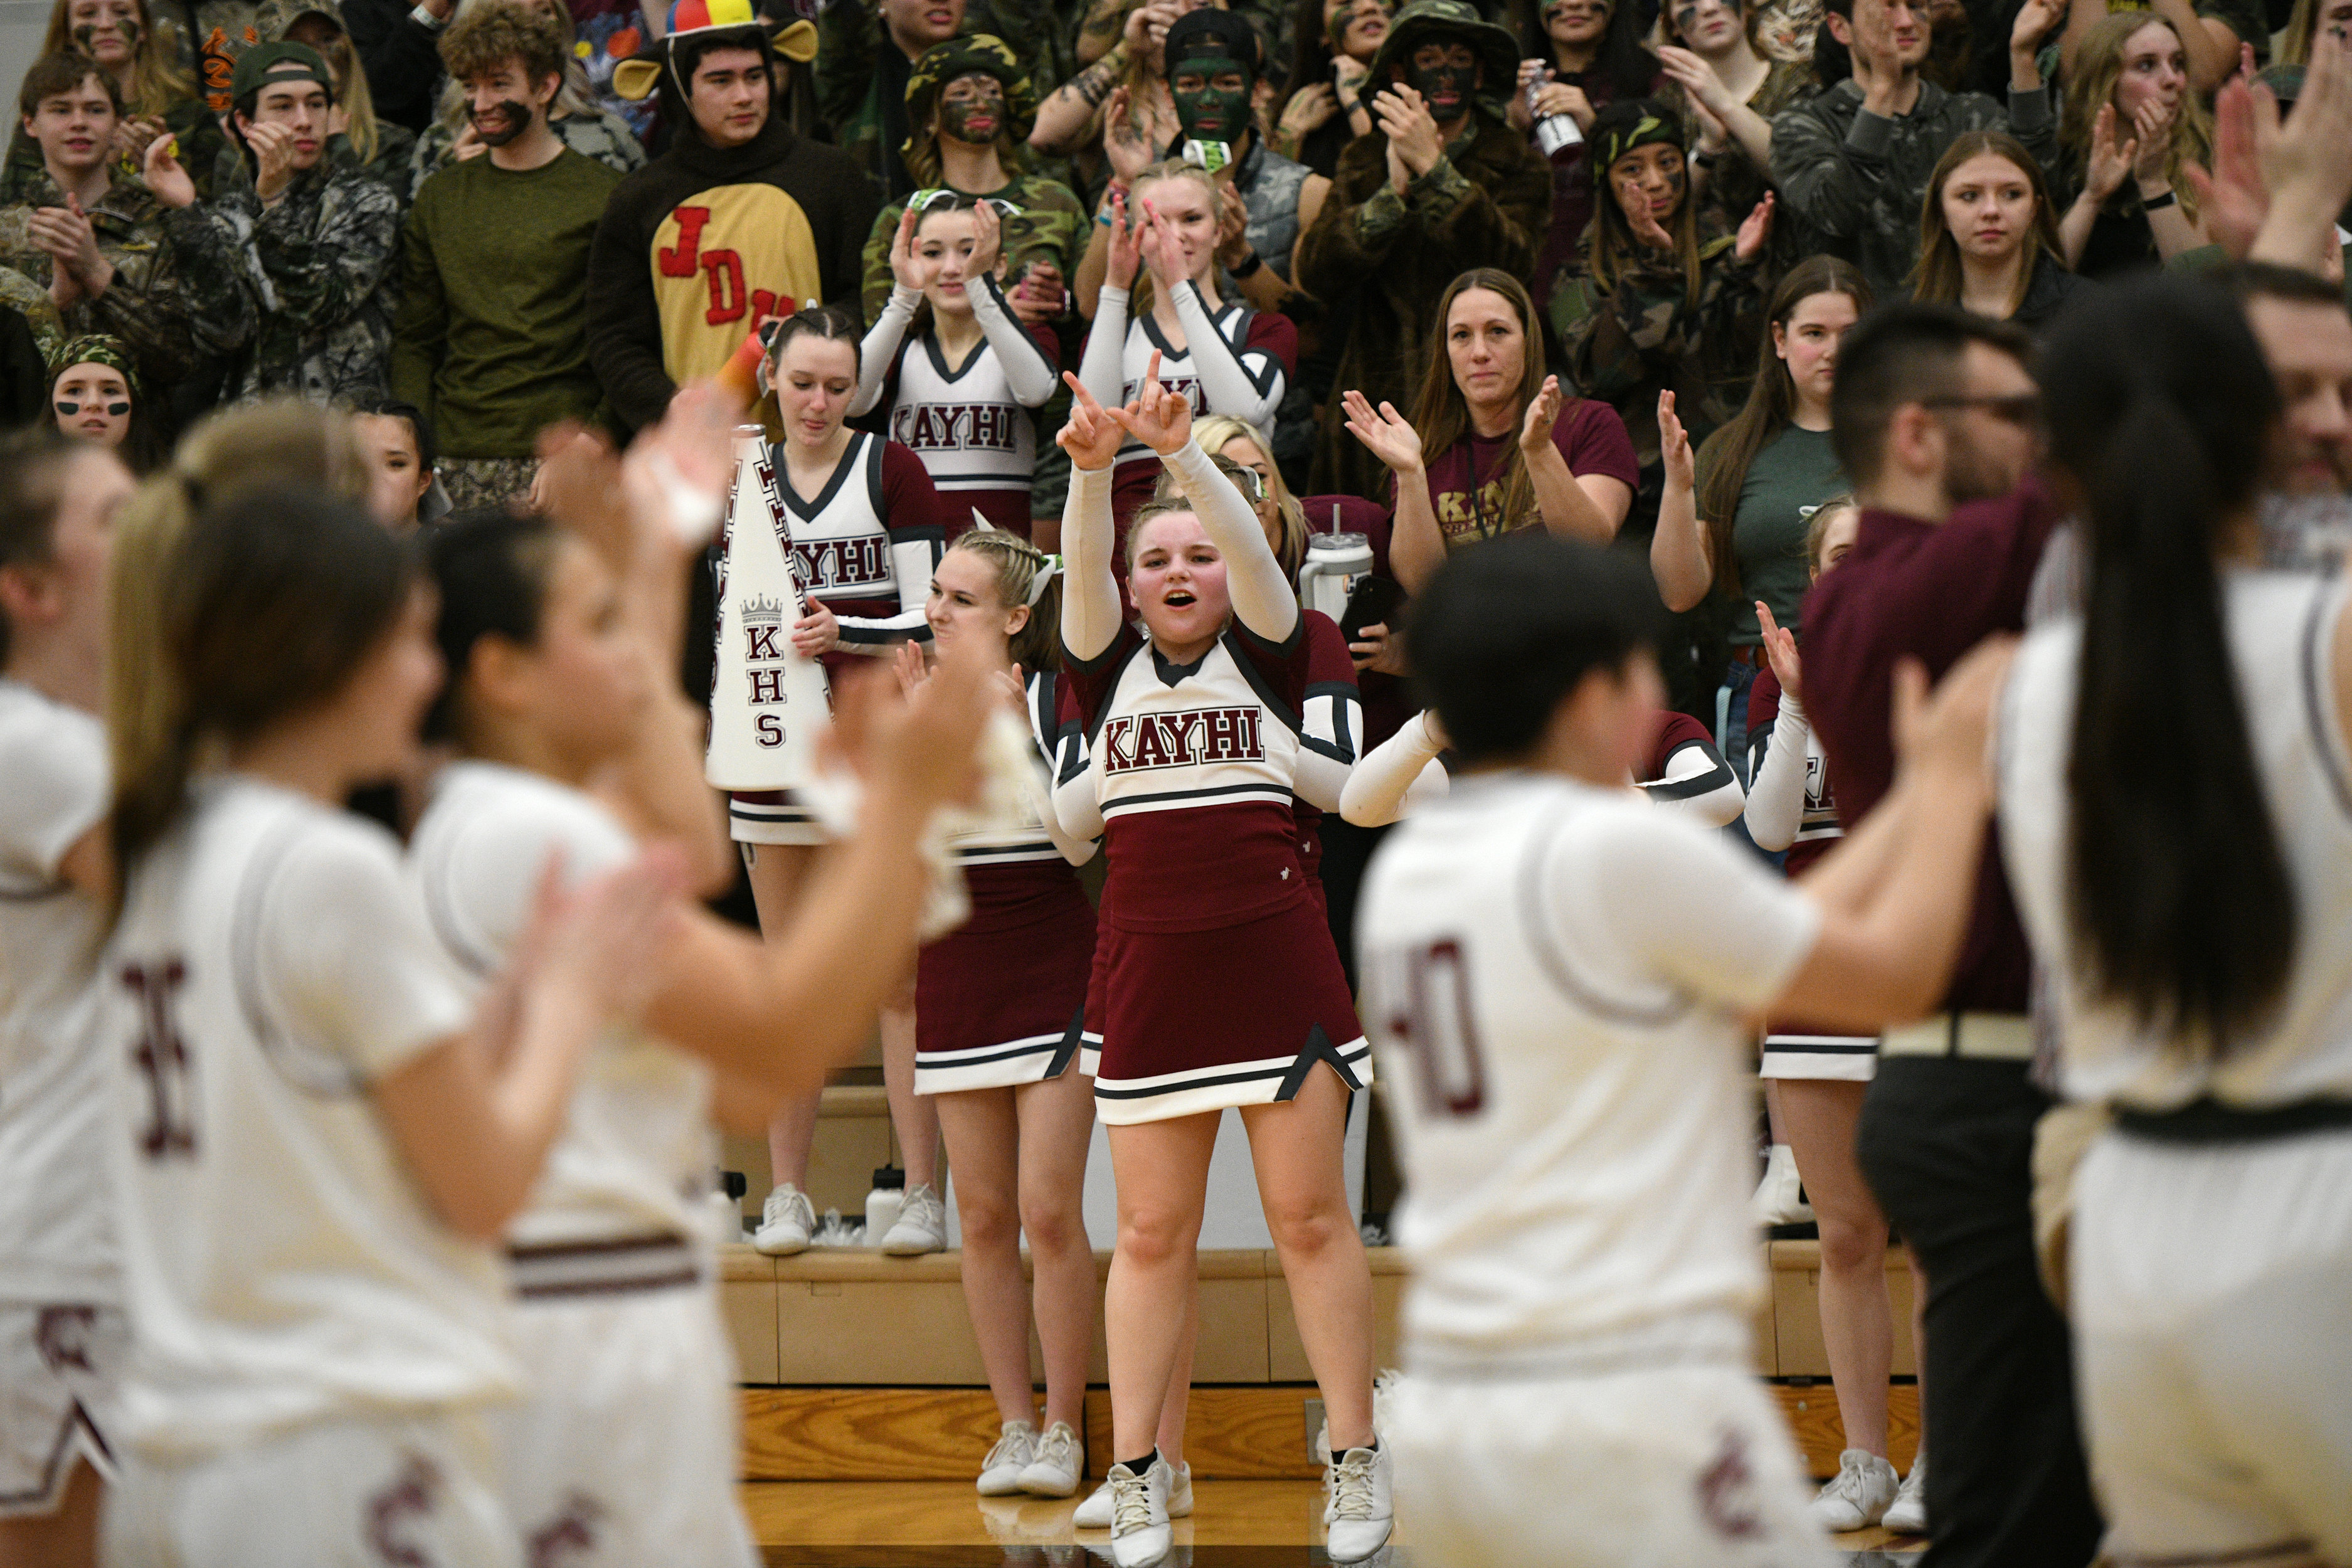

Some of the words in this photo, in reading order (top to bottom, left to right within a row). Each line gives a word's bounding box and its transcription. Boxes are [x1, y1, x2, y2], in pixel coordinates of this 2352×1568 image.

[894, 402, 1016, 452] KAYHI
[793, 533, 889, 590] YHI
[1104, 706, 1265, 776] KAYHI
